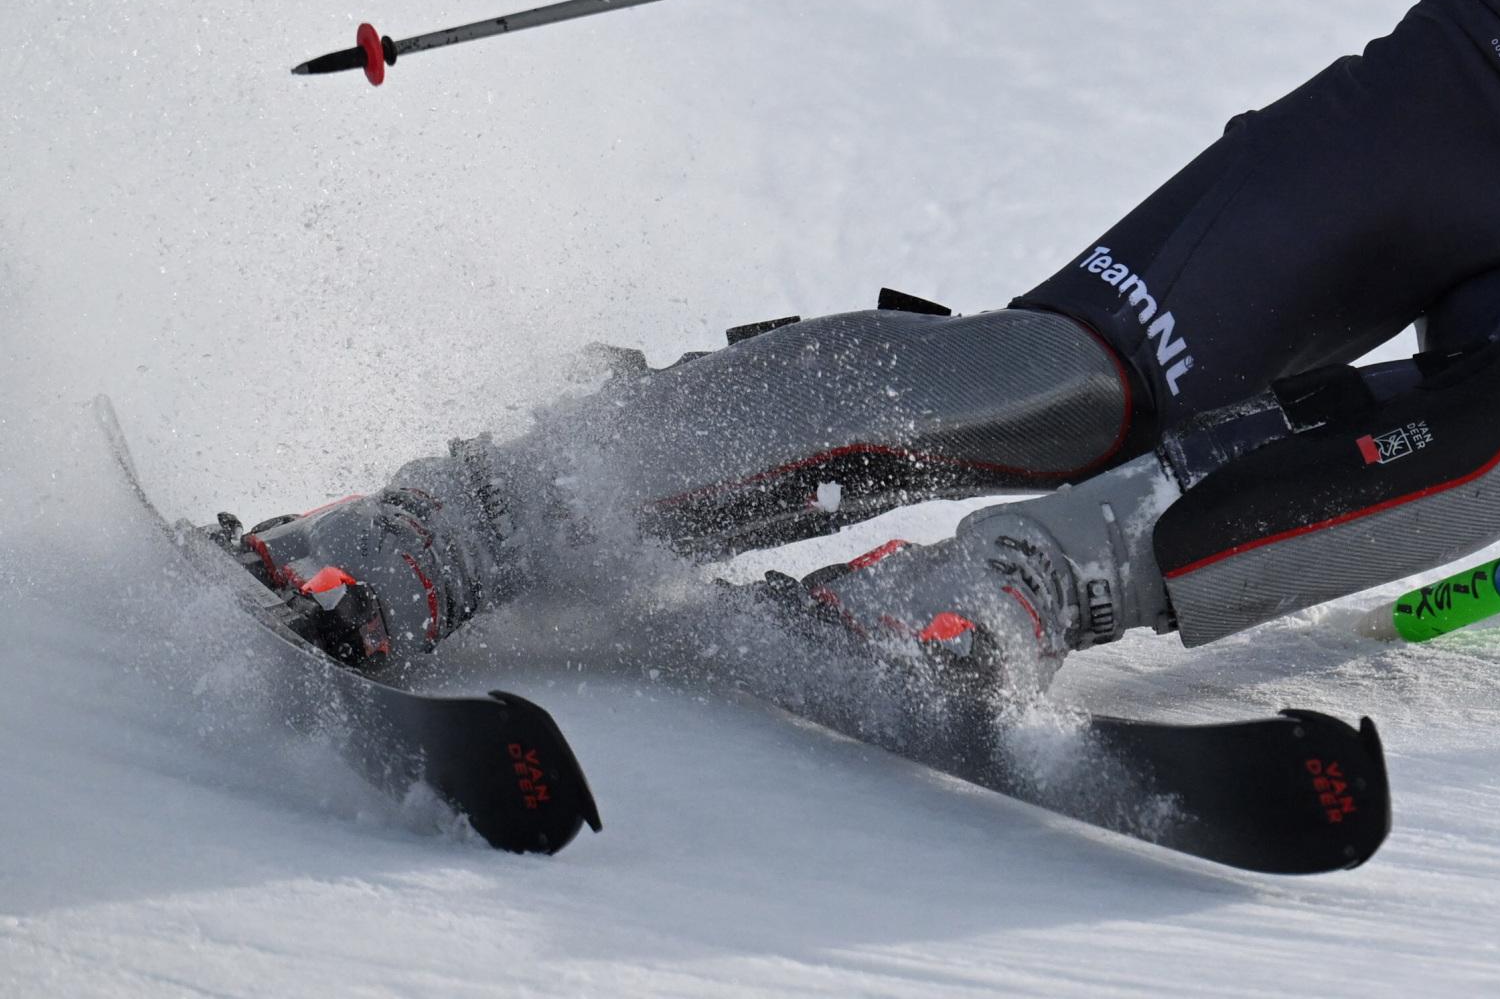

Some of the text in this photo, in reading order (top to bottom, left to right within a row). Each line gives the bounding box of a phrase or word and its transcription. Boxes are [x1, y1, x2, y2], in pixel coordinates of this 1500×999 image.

[1079, 246, 1190, 397] TeamNL
[1406, 422, 1426, 450] DEER
[1417, 420, 1434, 443] VAN
[507, 742, 538, 809] DEER
[525, 748, 551, 802] VAN
[1304, 758, 1343, 825] DEER
[1326, 760, 1357, 814] VAN
